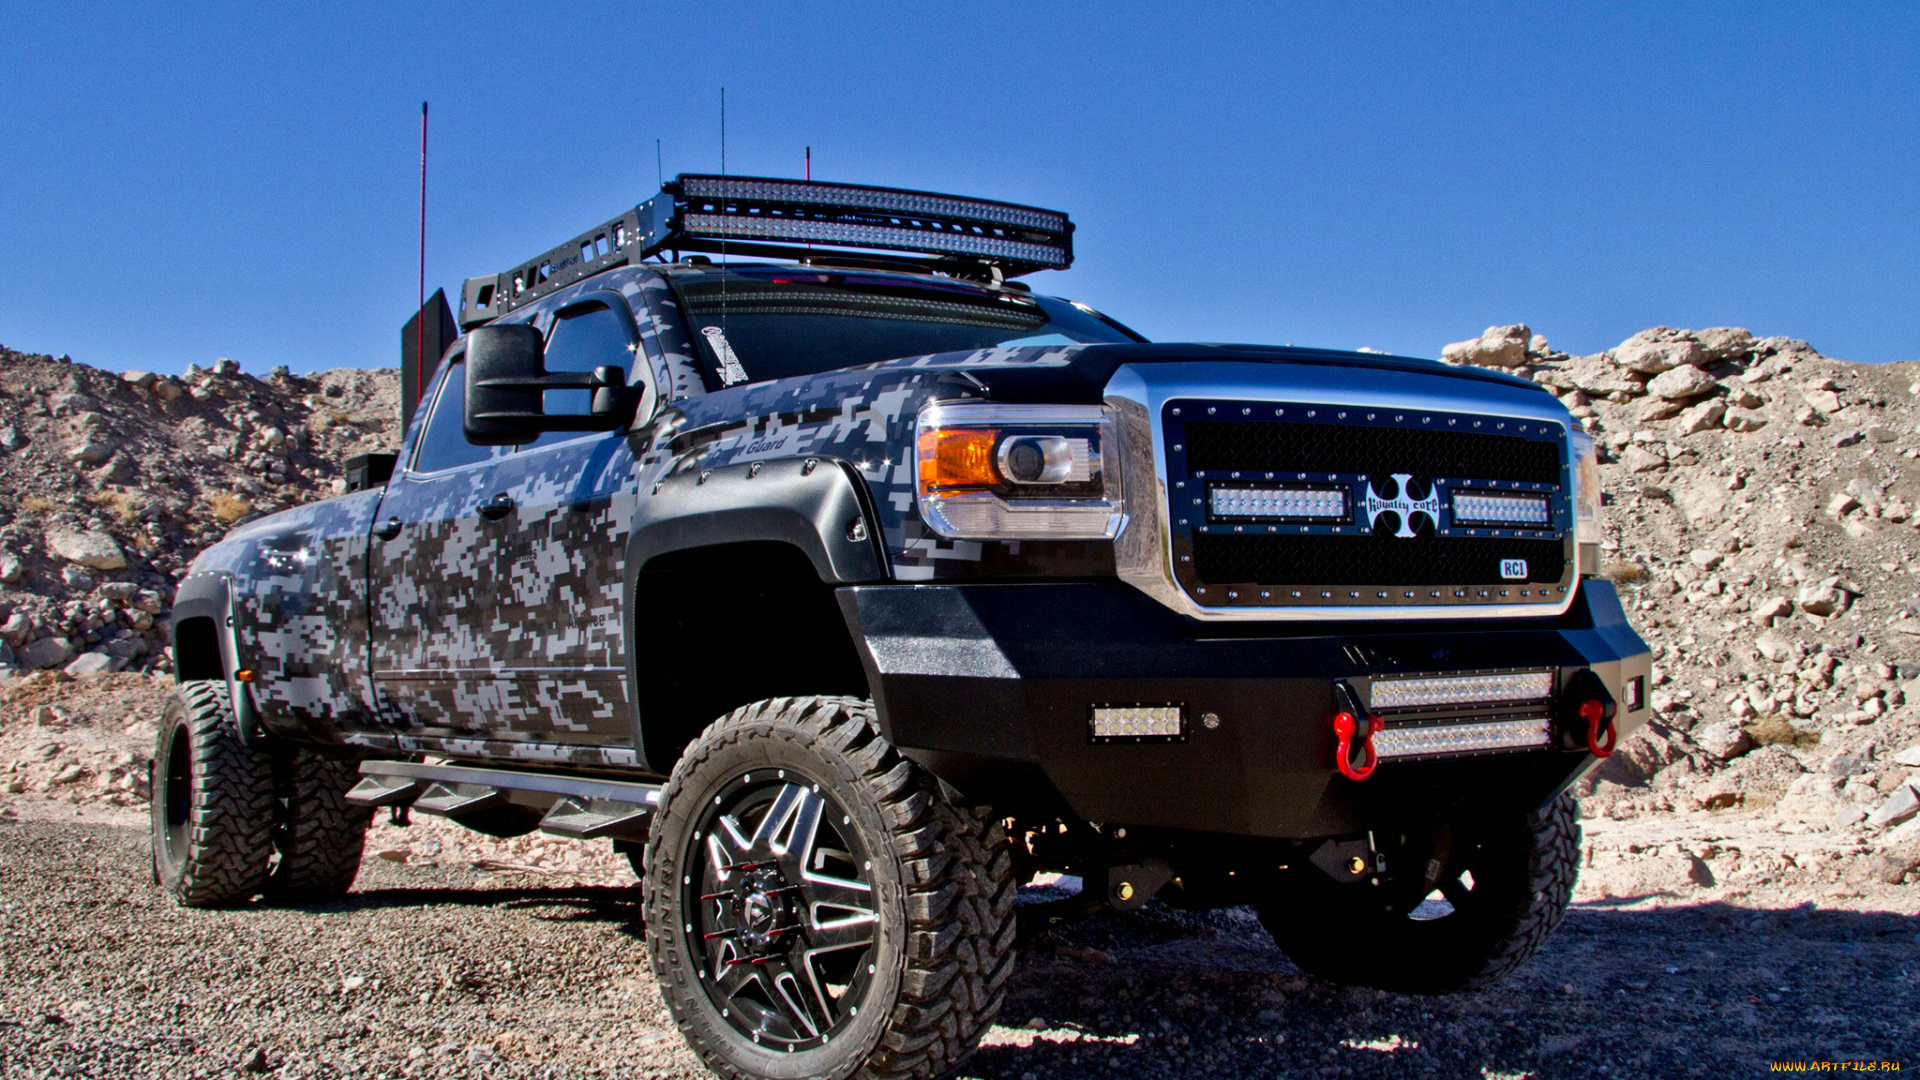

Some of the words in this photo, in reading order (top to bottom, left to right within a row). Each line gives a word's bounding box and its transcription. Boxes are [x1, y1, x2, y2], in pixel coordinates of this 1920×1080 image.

[746, 436, 788, 455] Guard
[1368, 497, 1409, 515] Royalty
[660, 850, 688, 989] COUNTRY
[685, 995, 735, 1058] OPEN
